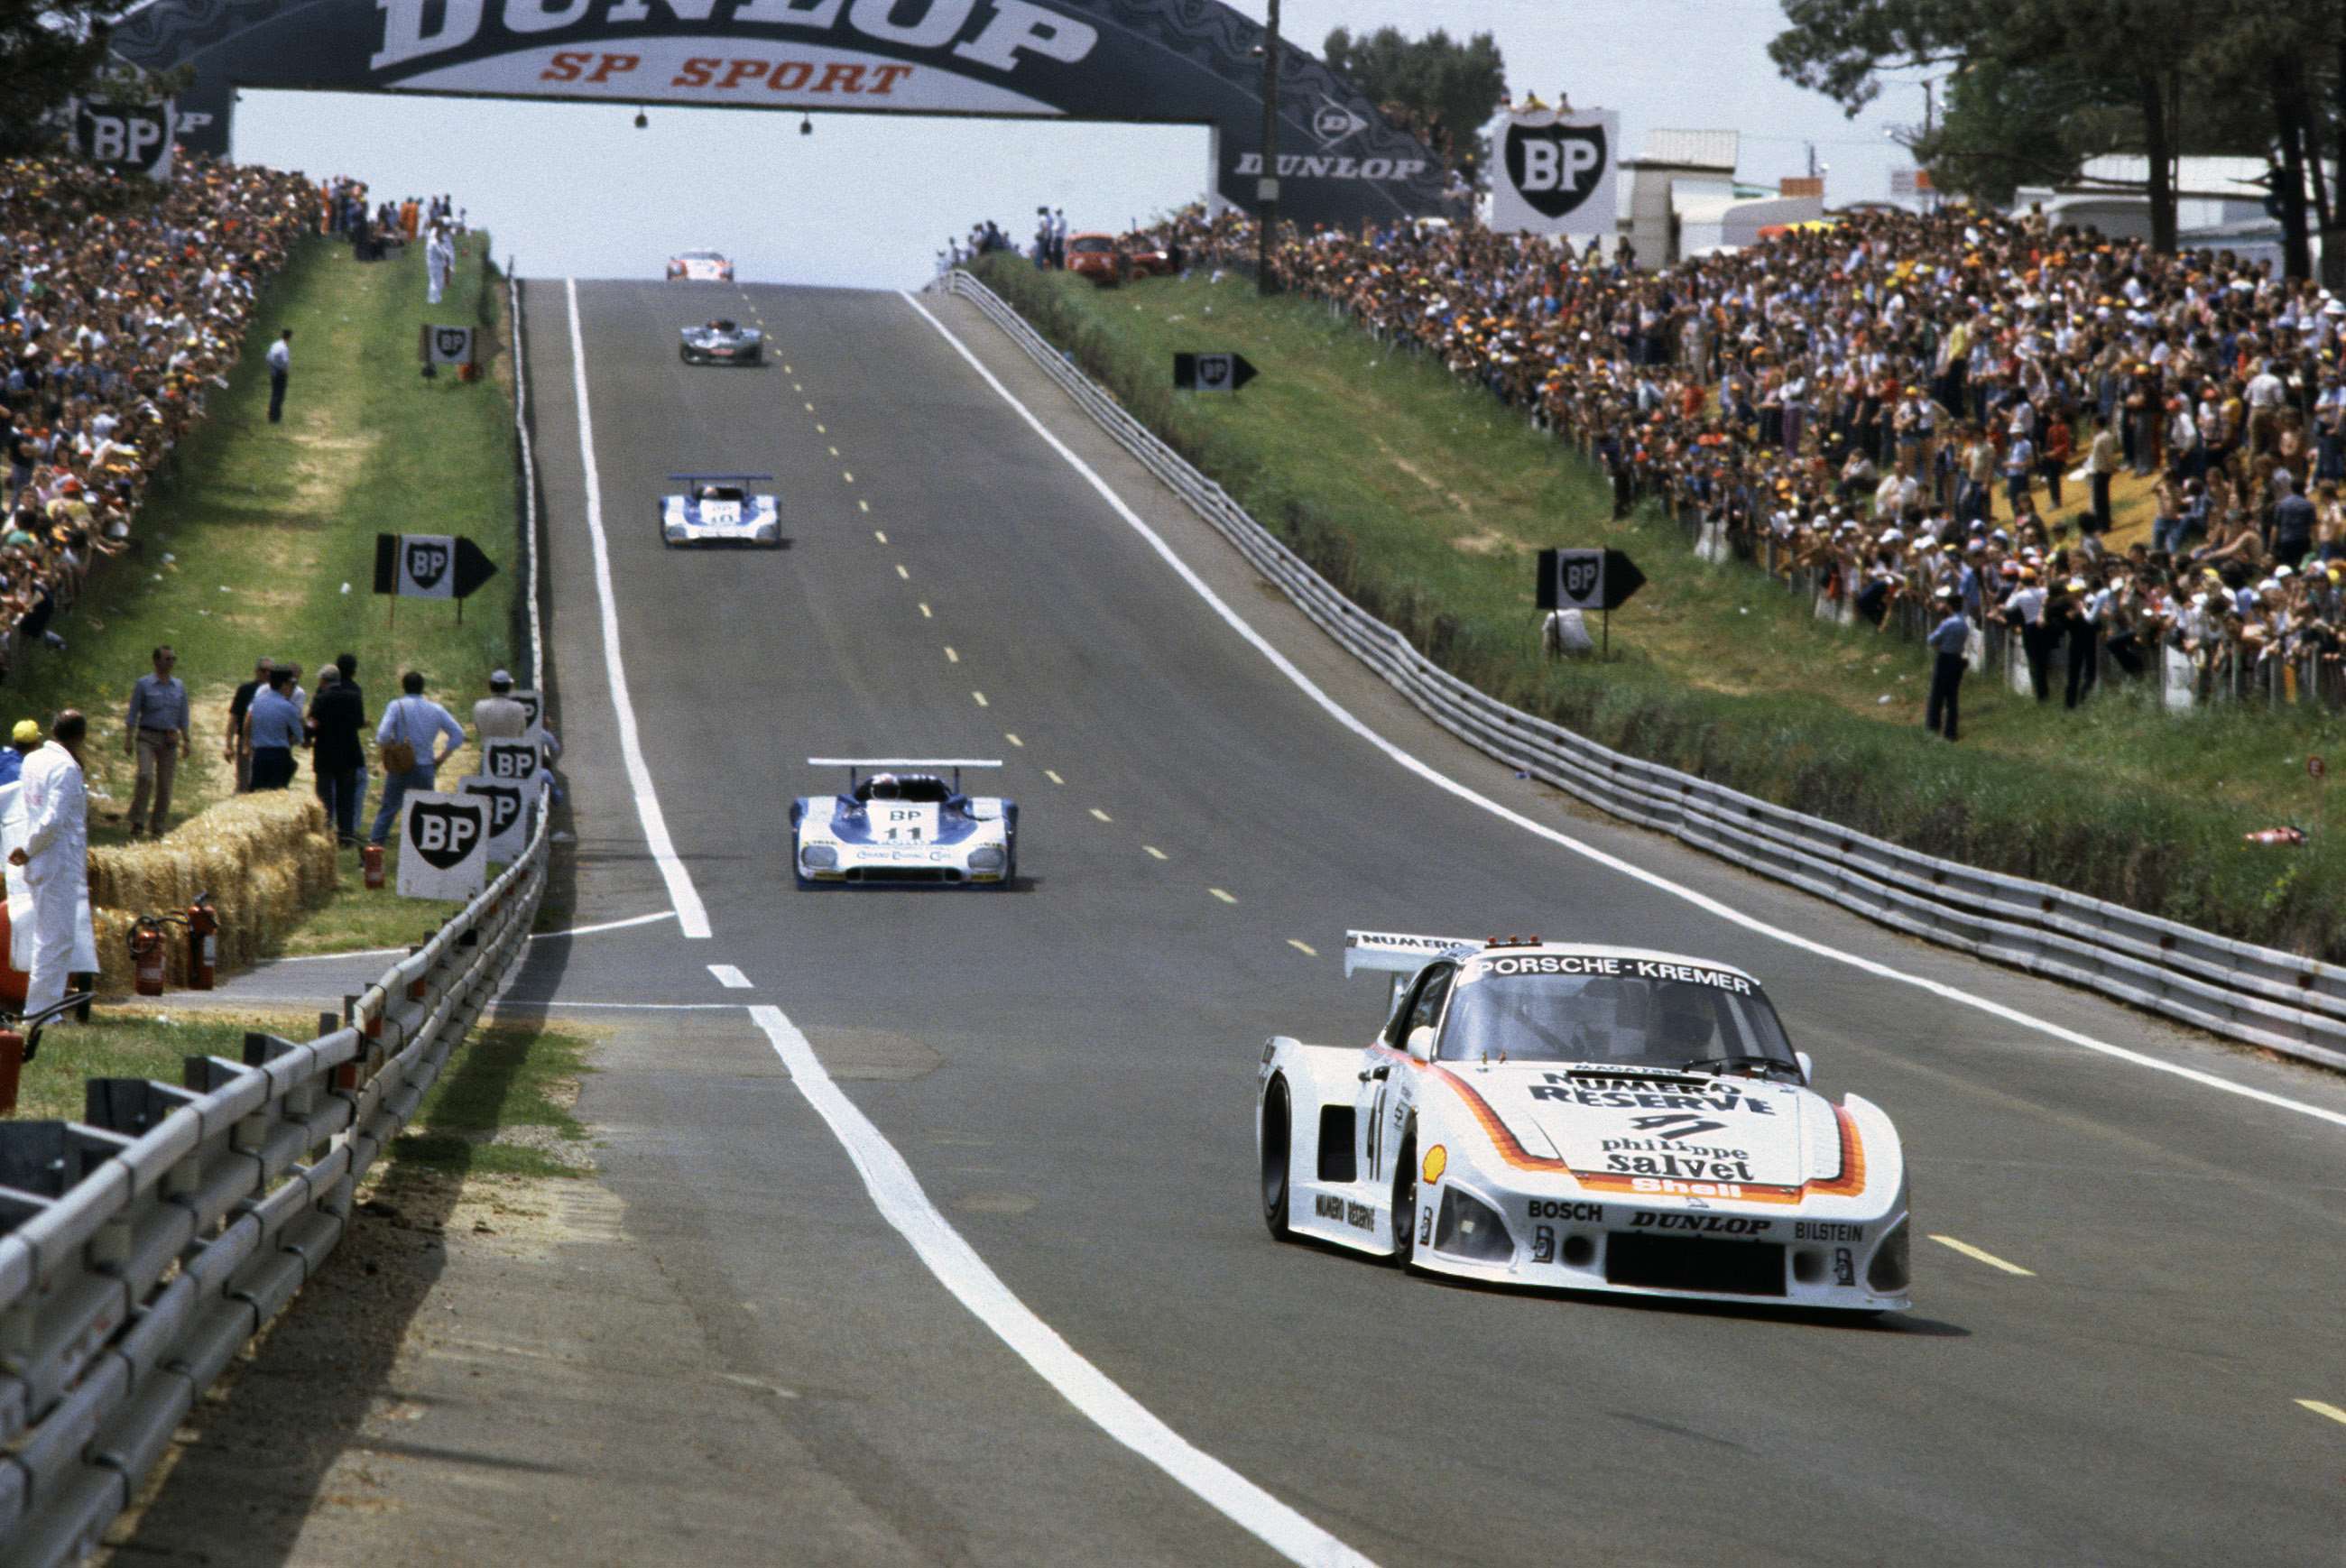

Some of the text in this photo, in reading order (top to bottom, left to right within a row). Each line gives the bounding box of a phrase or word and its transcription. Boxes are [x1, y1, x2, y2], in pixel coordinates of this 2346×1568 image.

[370, 0, 1099, 72] DOP
[540, 51, 914, 95] SP SPORT
[94, 115, 161, 163] BP
[1233, 152, 1427, 180] DUNLOP
[1519, 138, 1599, 192] BP
[412, 549, 446, 577] BP
[1567, 563, 1596, 591] BP
[497, 752, 533, 779] BP
[494, 796, 517, 826] P
[890, 810, 921, 822] BP
[419, 814, 476, 853] BP
[883, 826, 921, 840] 11
[1528, 1084, 1777, 1116] RESERVE
[1601, 1139, 1750, 1161] philippe
[1606, 1154, 1755, 1181] salvet
[1631, 1176, 1742, 1198] Shell
[1528, 1200, 1603, 1222] BOSCH
[1629, 1211, 1772, 1236] DUNLOP
[1795, 1222, 1864, 1243] BILSTEIN
